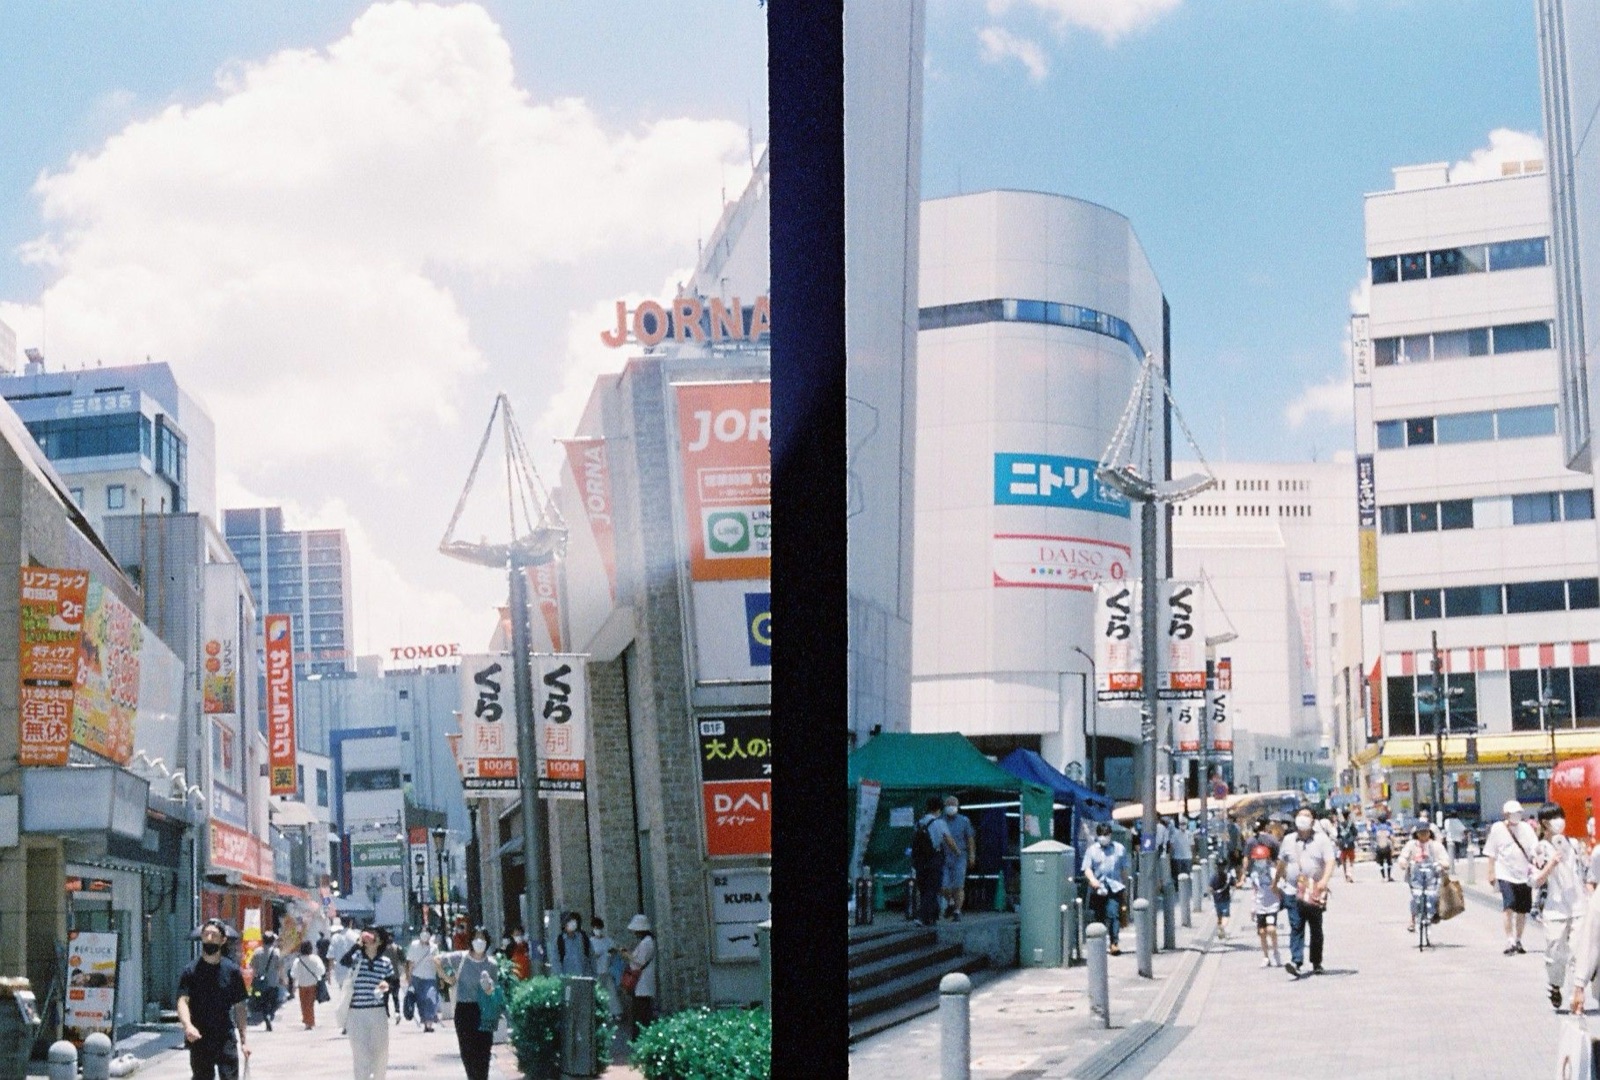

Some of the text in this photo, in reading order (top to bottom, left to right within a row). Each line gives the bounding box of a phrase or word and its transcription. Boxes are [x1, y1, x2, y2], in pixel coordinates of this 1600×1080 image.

[600, 295, 770, 348] JORNA
[584, 446, 612, 524] JORNA
[1010, 462, 1089, 499] ニトリ
[1039, 547, 1104, 566] DAISO
[23, 571, 87, 589] リフラック
[62, 600, 83, 618] 2F
[1106, 587, 1131, 640] くら
[1168, 587, 1194, 640] くら
[390, 643, 461, 660] TOMOE
[270, 649, 291, 758] サンドラッグ
[474, 662, 503, 723] くら
[543, 663, 572, 724] くら
[24, 701, 68, 719] 年中
[1212, 693, 1226, 724] くら
[24, 722, 68, 741] 無休
[484, 760, 513, 771] 100円
[550, 761, 579, 772] 100円
[724, 893, 763, 904] KURA
